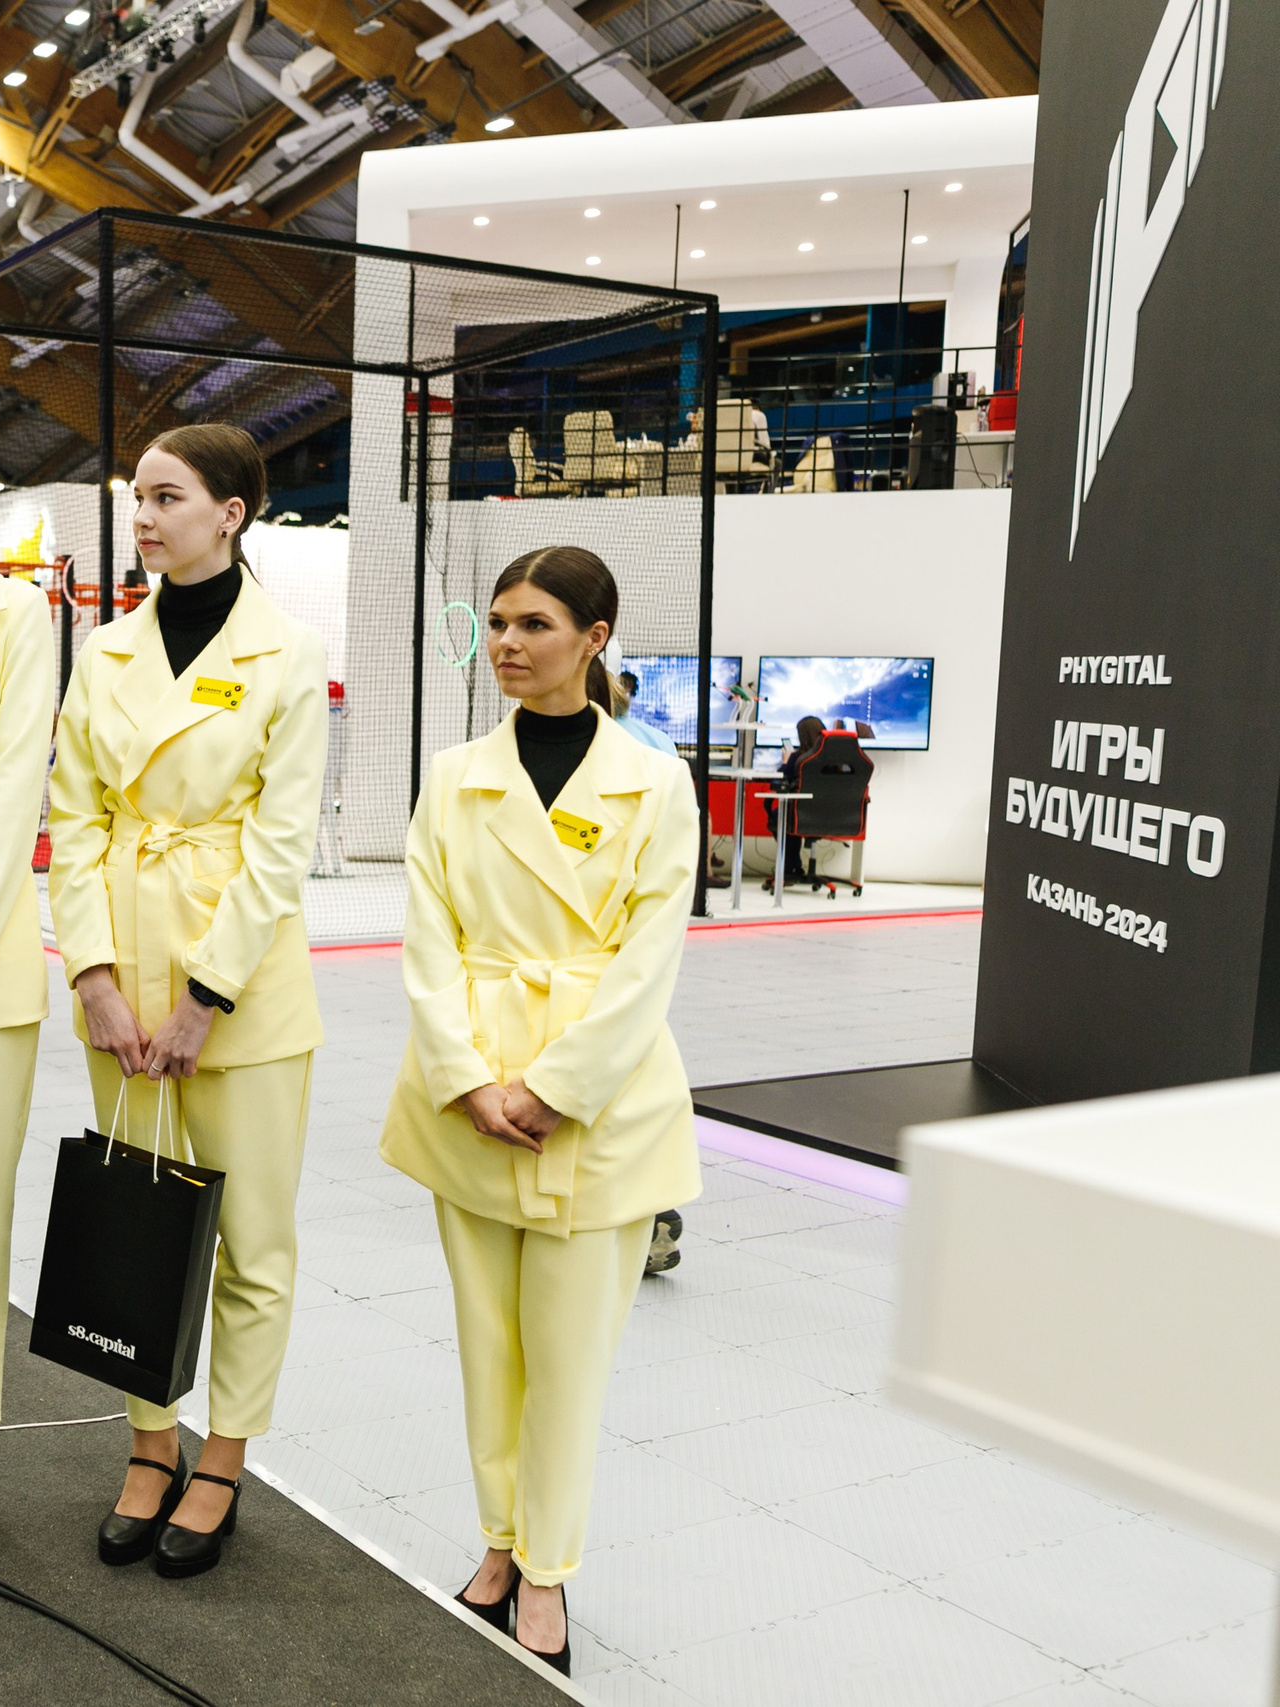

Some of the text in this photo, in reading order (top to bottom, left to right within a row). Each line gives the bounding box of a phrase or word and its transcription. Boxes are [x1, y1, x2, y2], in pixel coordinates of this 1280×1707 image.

[1059, 655, 1172, 685] PHYGITAL
[1051, 720, 1165, 784] ИГРЫ
[1006, 777, 1225, 878] БУДУЩЕГО
[1027, 873, 1168, 953] КАЗАНЬ 2024
[67, 1324, 136, 1360] s8.capital
